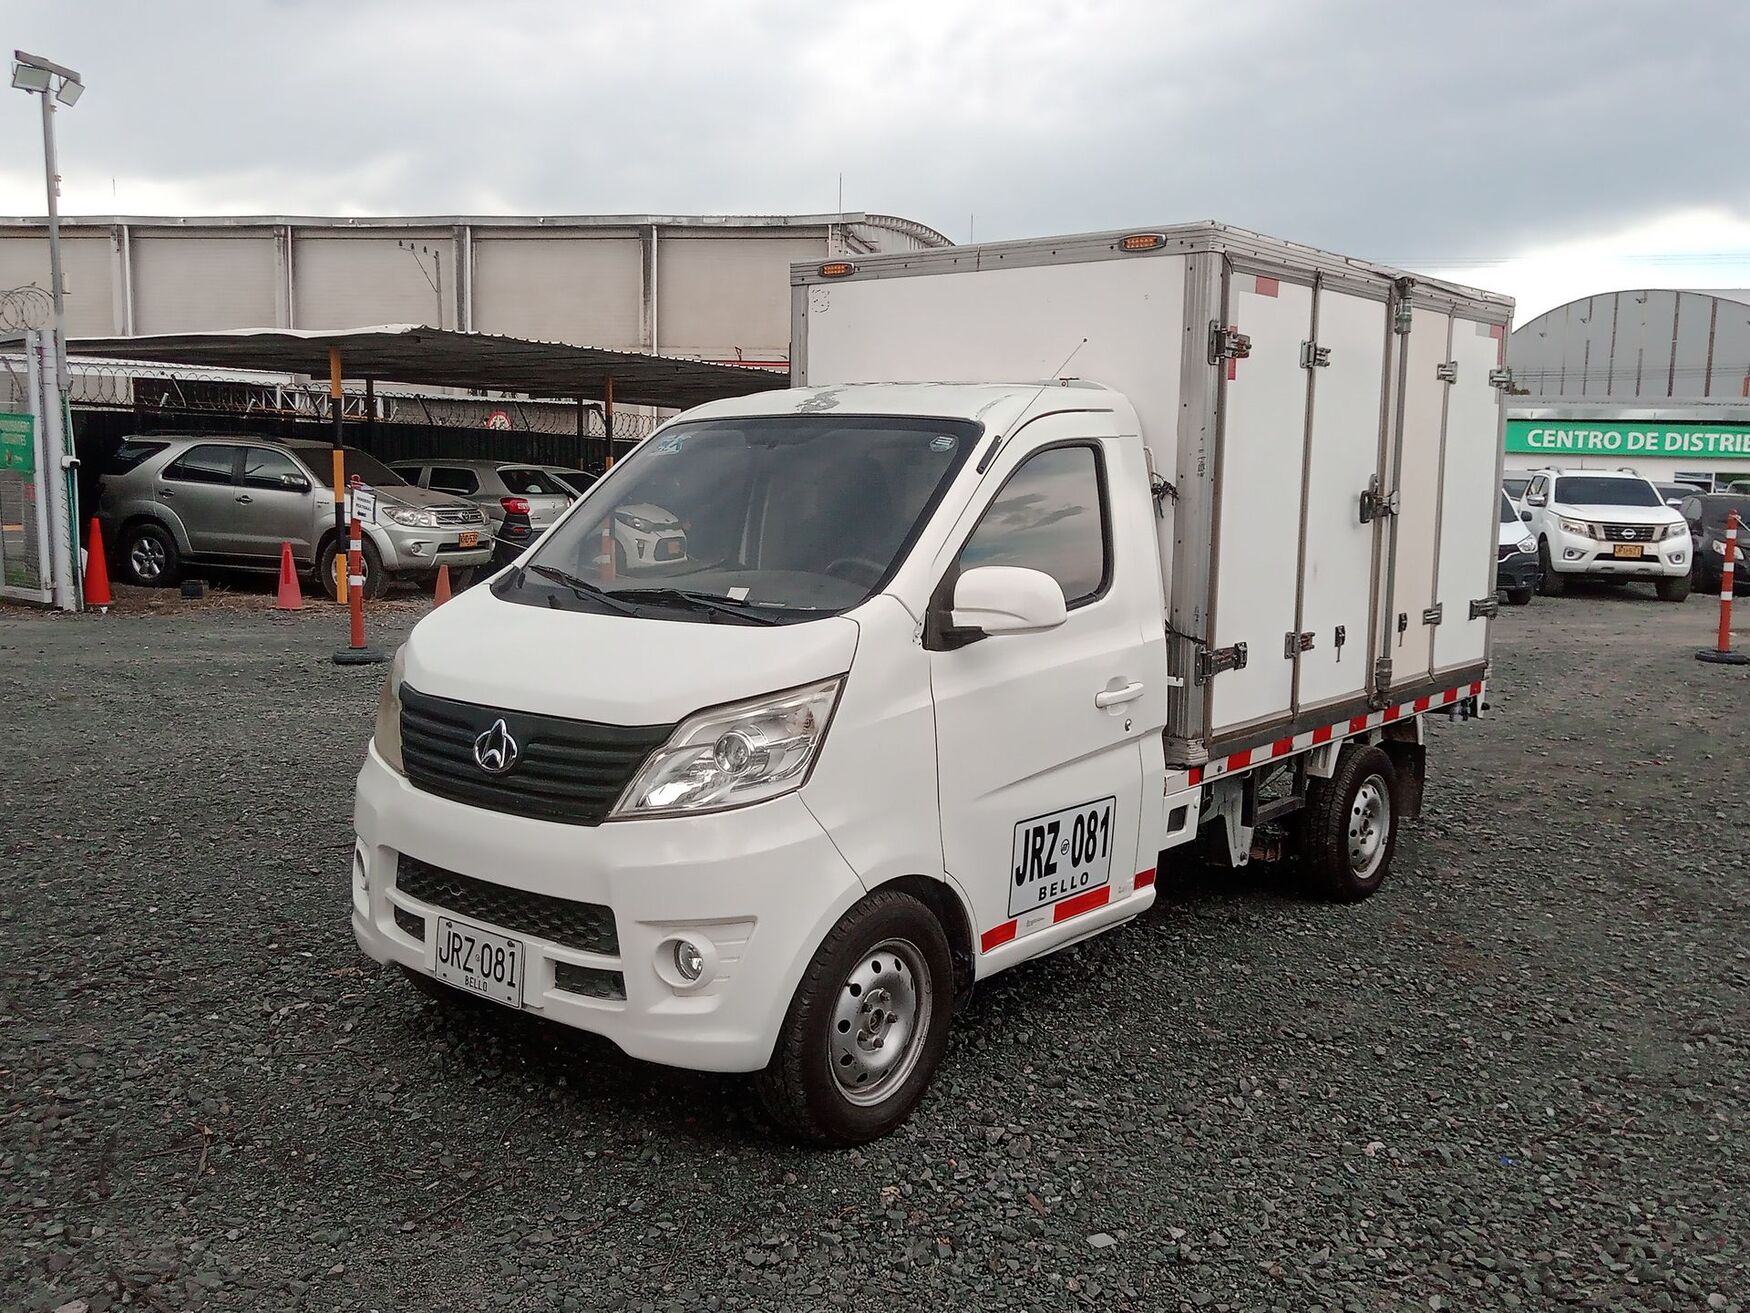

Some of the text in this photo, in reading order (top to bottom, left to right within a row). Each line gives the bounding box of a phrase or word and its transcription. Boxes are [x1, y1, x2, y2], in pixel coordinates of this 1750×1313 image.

[1527, 429, 1622, 450] CENTRO
[1626, 431, 1660, 450] DE
[1015, 805, 1111, 887] JRZ 081
[1038, 871, 1089, 902] BELLO
[438, 930, 516, 988] JRZ 081
[464, 975, 488, 992] BELLO
